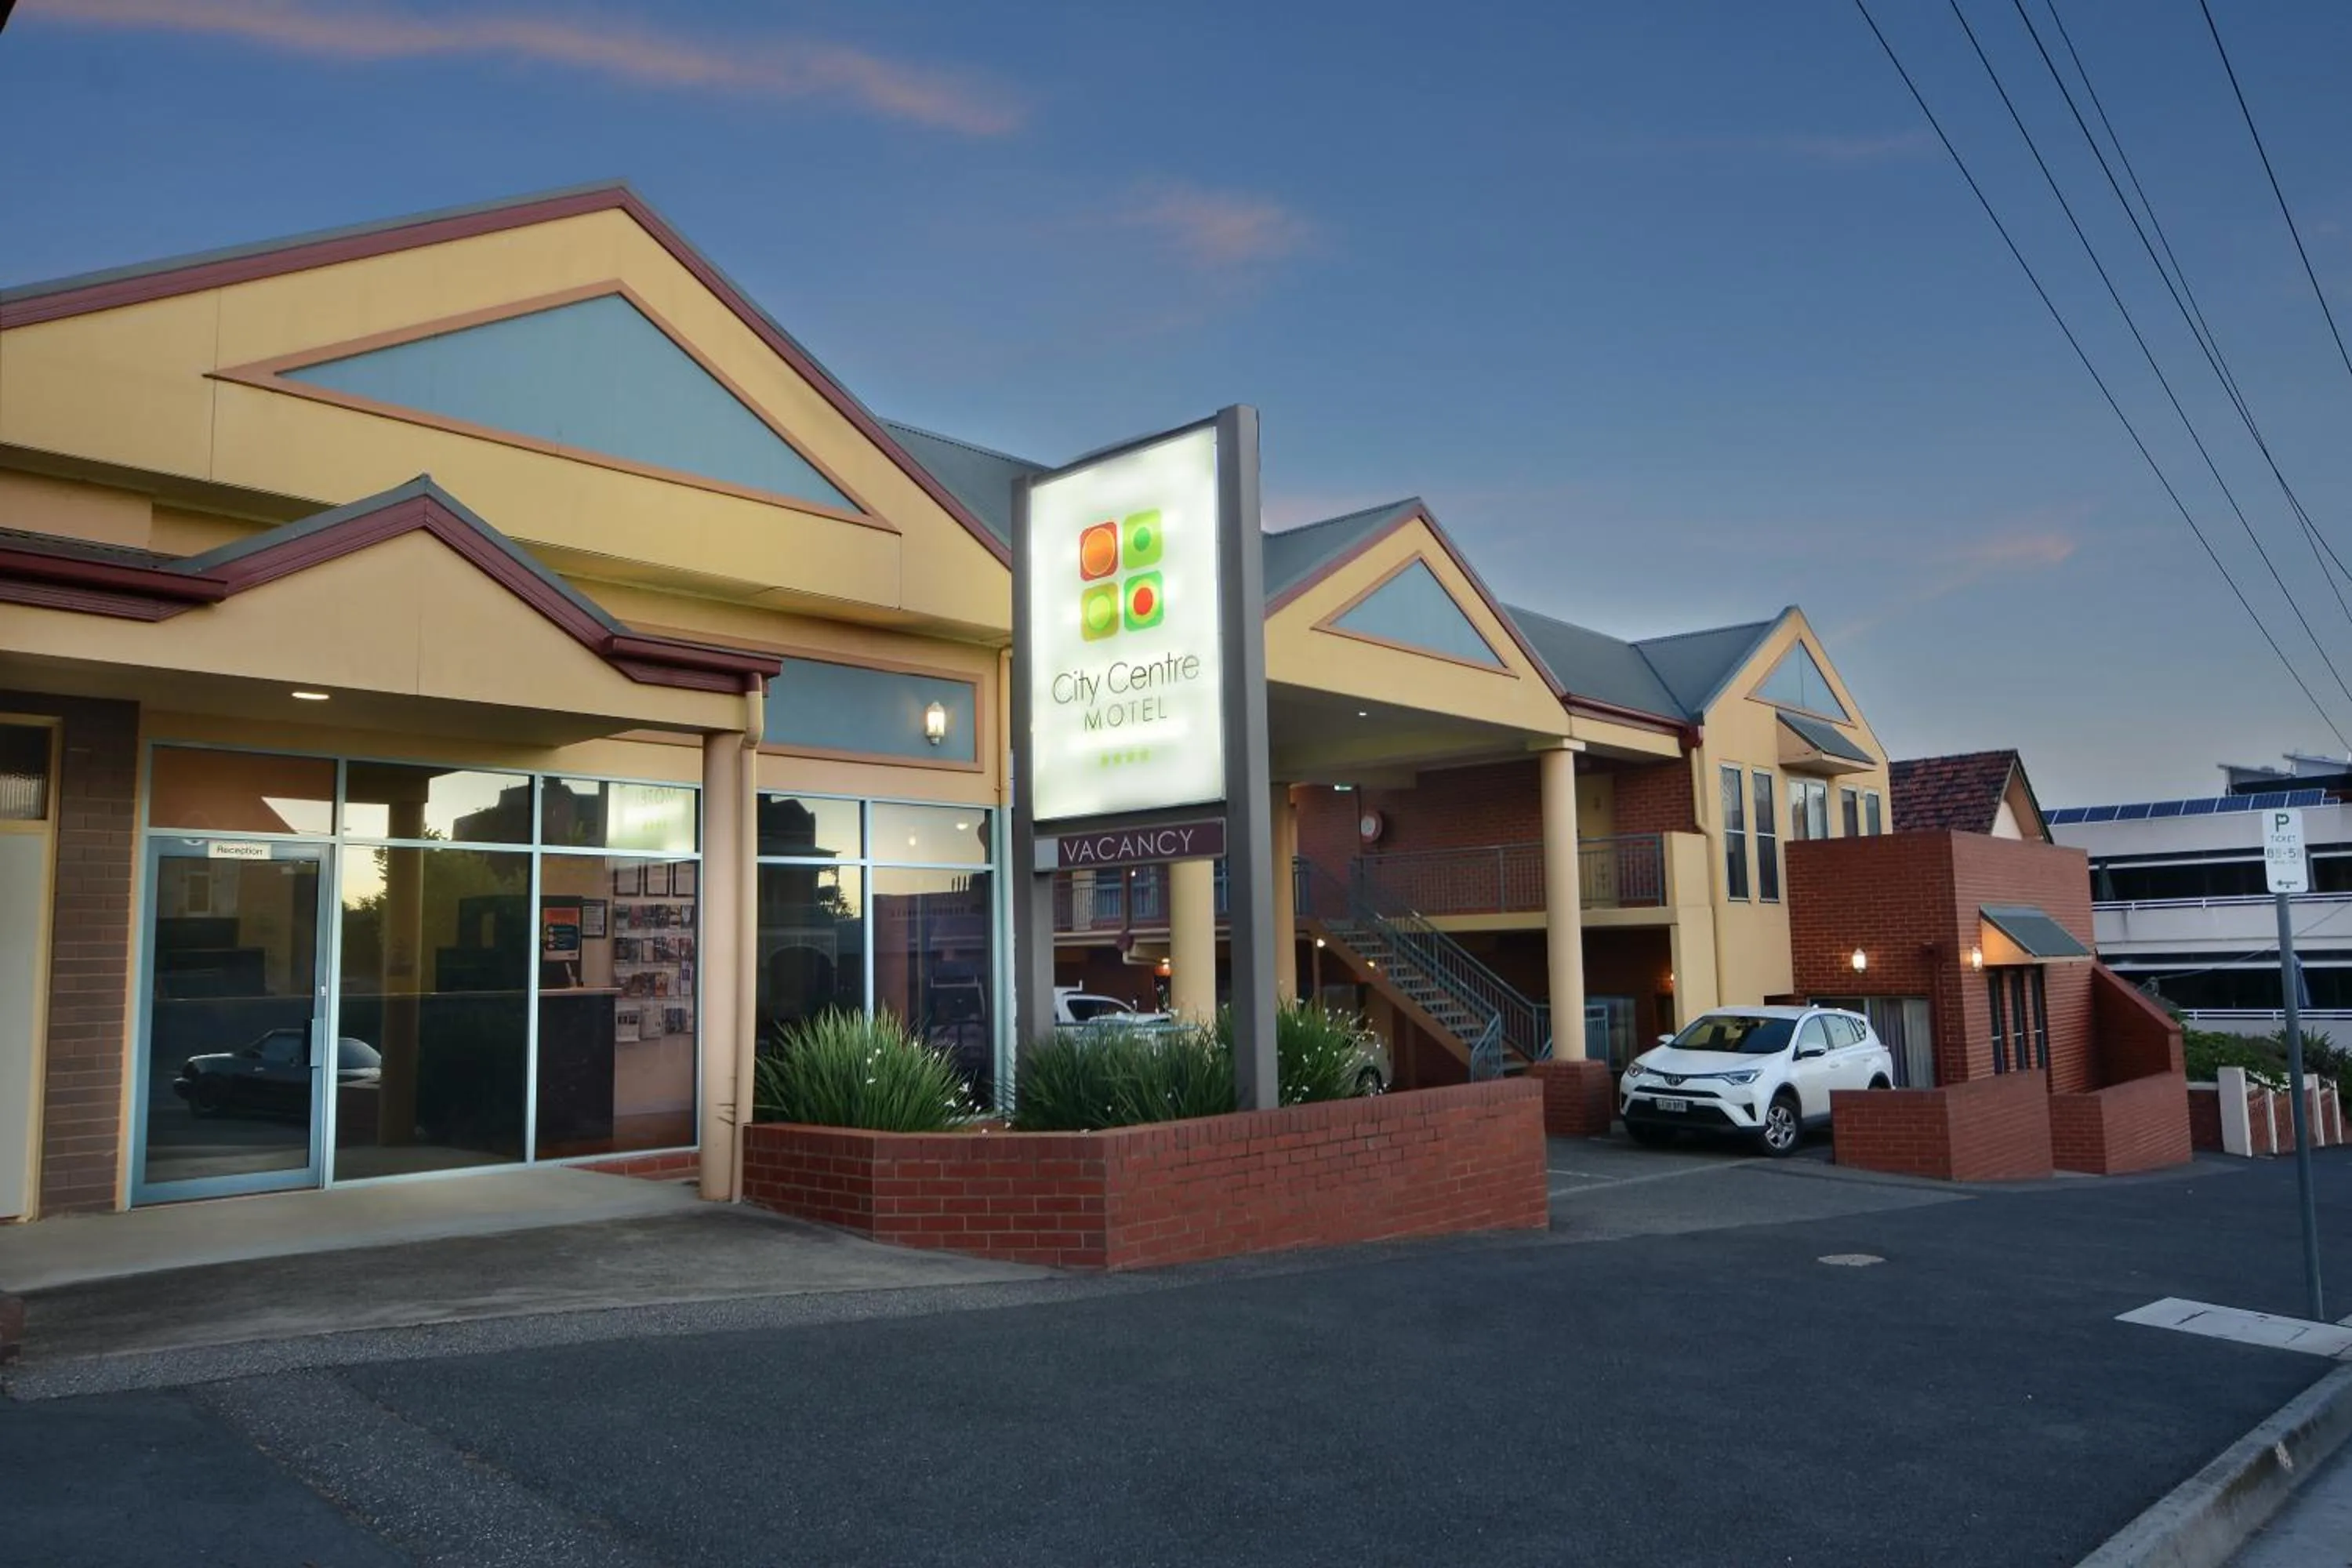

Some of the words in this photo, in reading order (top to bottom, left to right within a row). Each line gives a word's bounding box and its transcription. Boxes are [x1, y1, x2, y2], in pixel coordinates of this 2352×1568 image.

[1052, 670, 1101, 707] City
[1107, 652, 1200, 695] Centre
[1083, 696, 1167, 731] MOTEL
[2274, 813, 2290, 833] P
[216, 844, 263, 856] Reception
[1063, 829, 1194, 862] VACANCY
